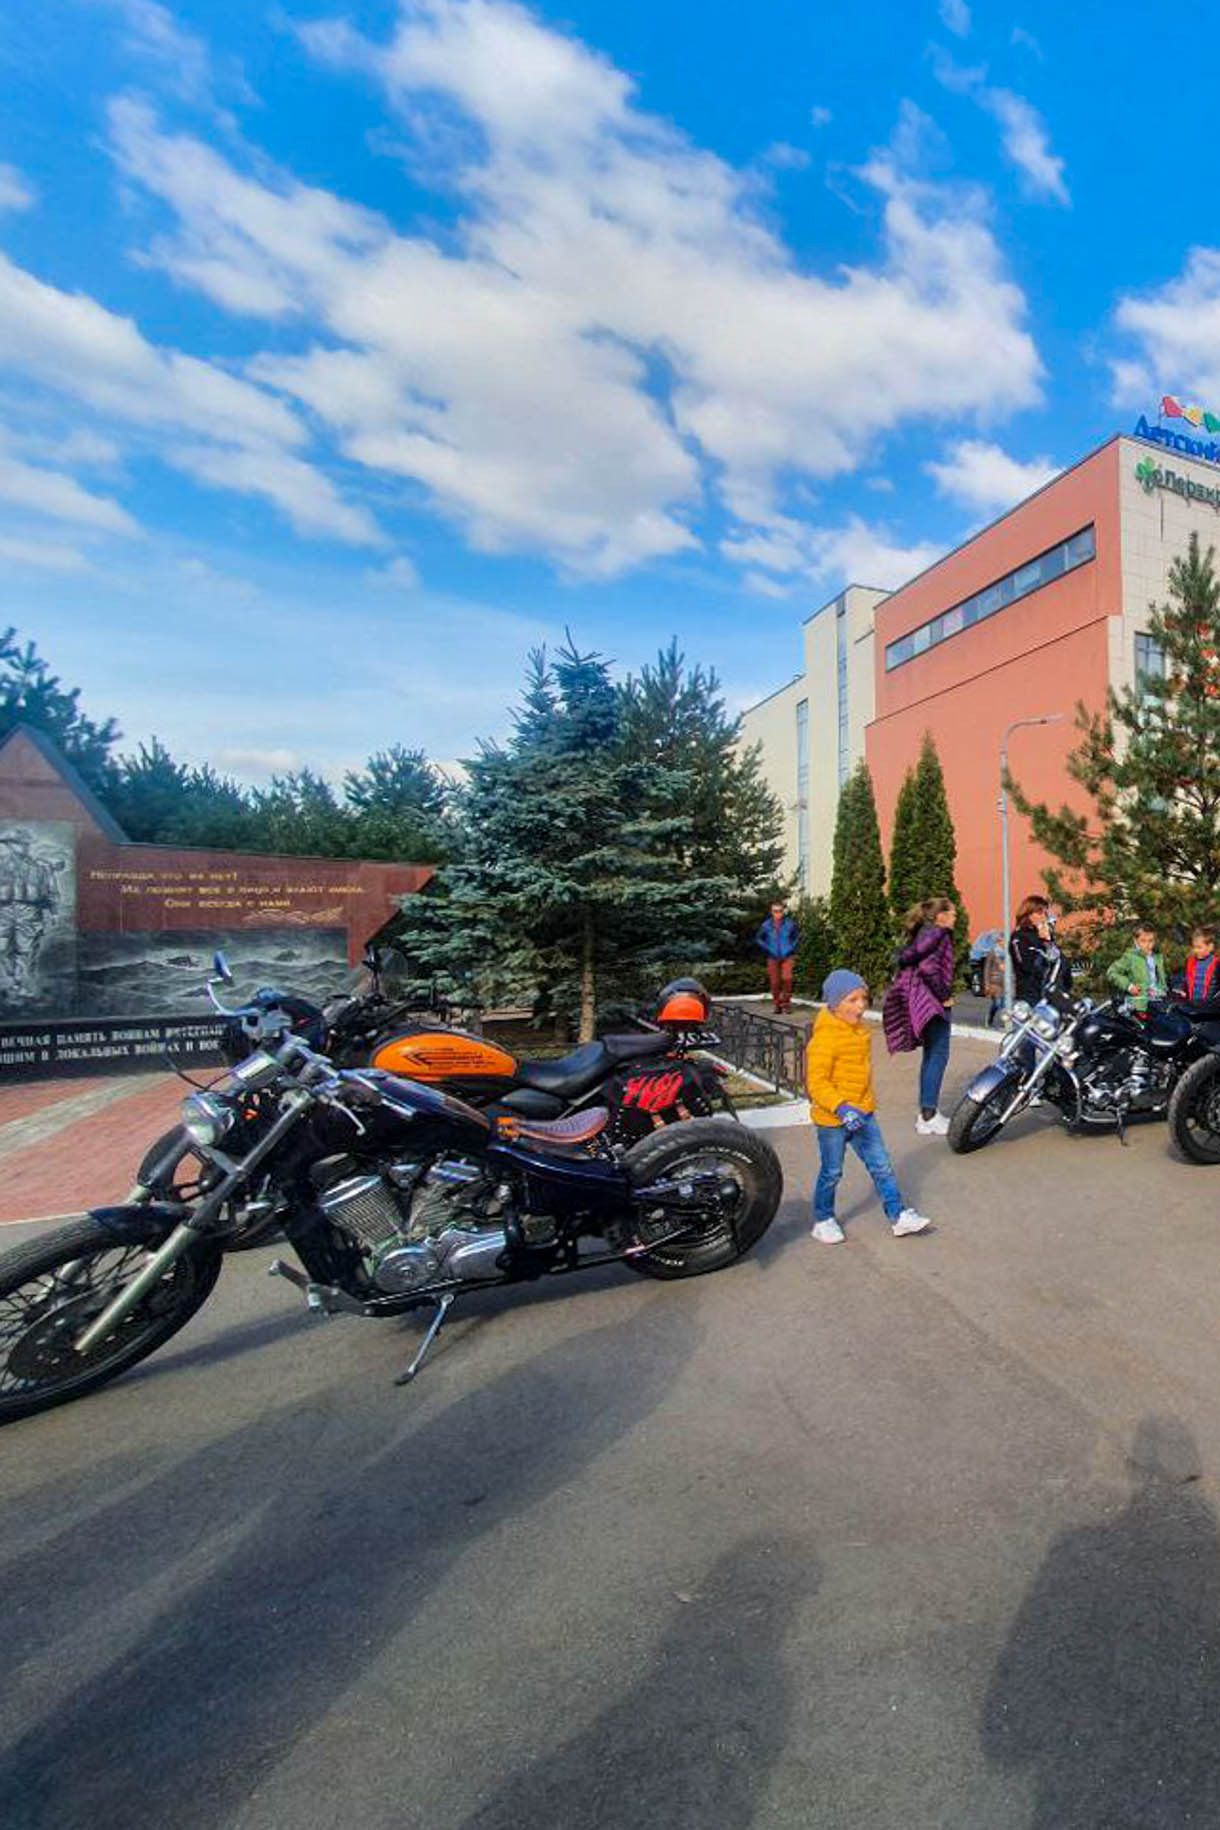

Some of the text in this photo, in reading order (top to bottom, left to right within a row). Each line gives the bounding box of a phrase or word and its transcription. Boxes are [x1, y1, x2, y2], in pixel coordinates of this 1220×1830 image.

[1, 1034, 51, 1049] ВЕЧНАЯ
[56, 1032, 105, 1045] ПАМЯТЬ
[56, 1045, 130, 1060] ЛОКАЛЬНЫХ
